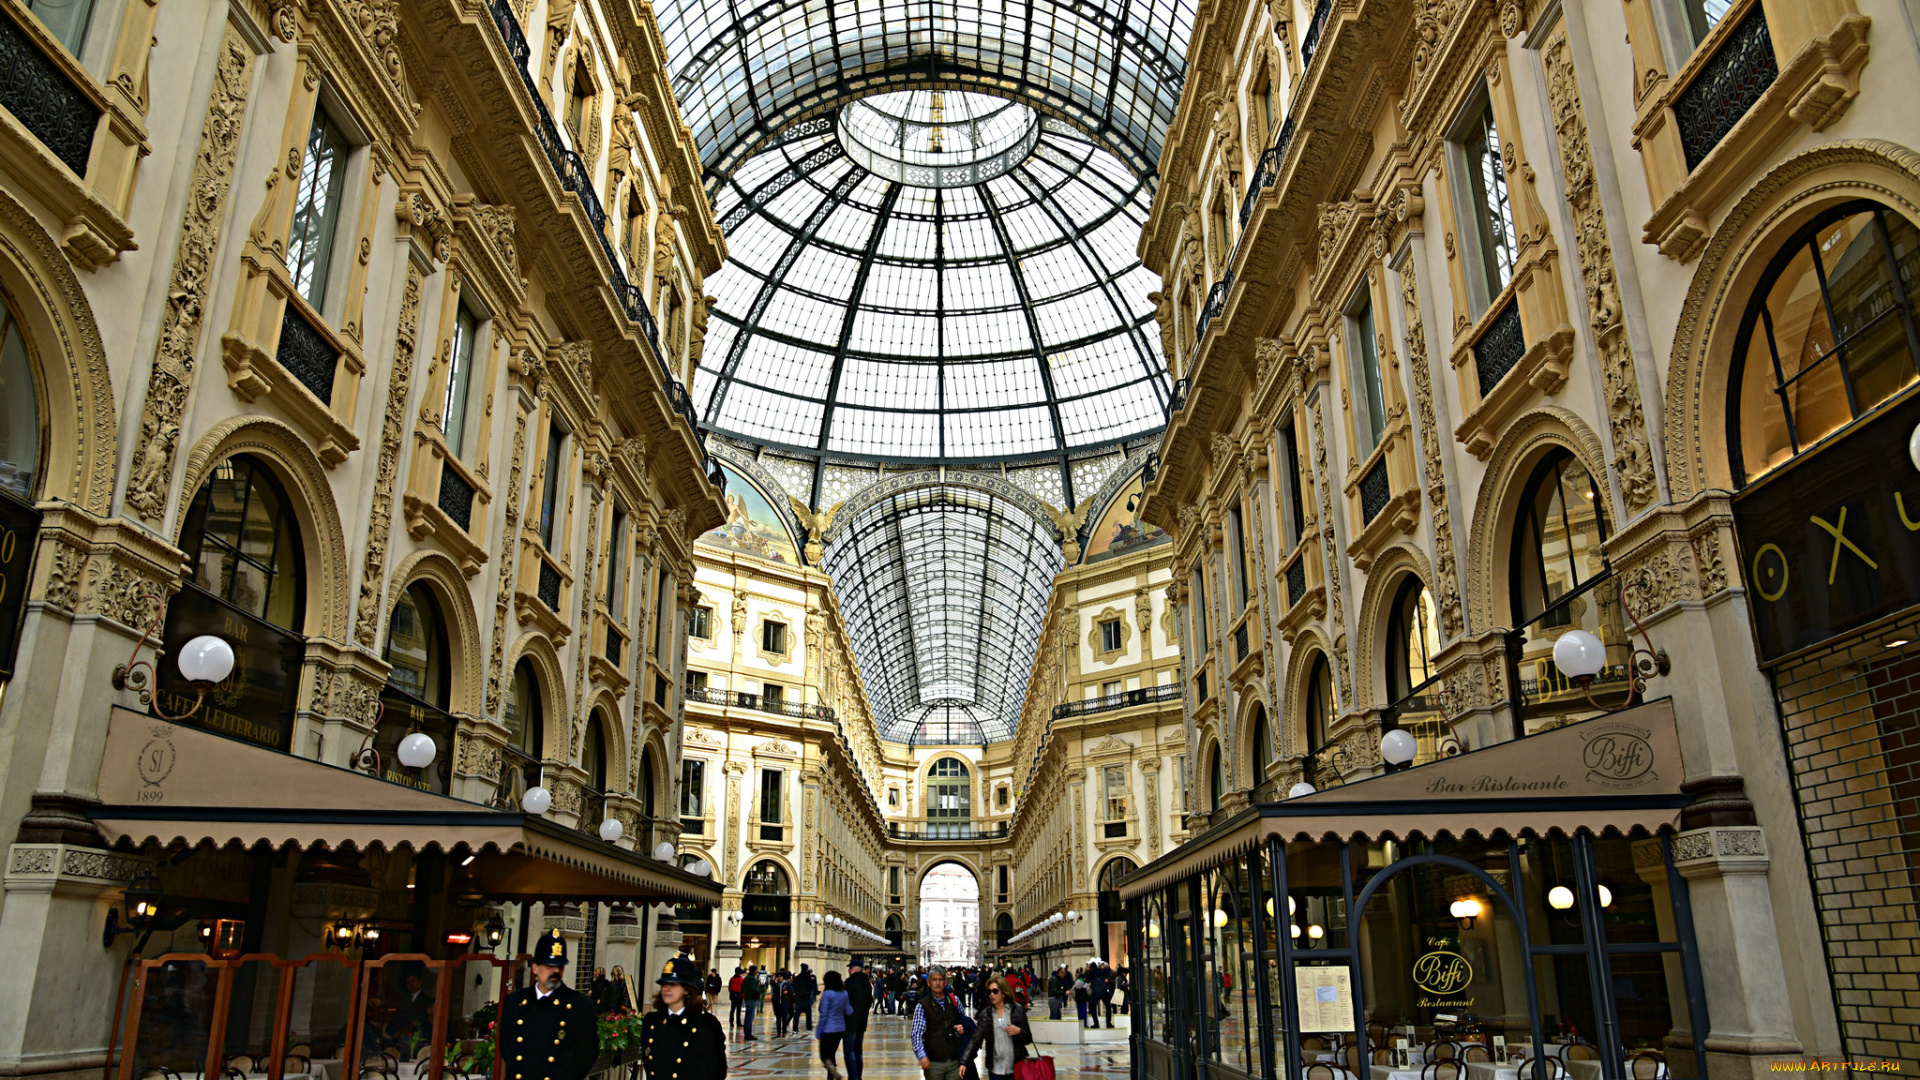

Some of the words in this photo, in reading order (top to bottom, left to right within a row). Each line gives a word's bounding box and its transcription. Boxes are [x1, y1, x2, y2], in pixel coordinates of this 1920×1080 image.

[225, 616, 248, 643] BAR
[410, 704, 425, 723] BAR
[204, 705, 280, 746] LETTERARIO
[149, 749, 164, 773] SI
[1586, 737, 1645, 777] Biffi
[1426, 776, 1466, 793] Bar
[1471, 774, 1569, 792] Ristorante
[136, 791, 164, 803] 1899
[753, 905, 777, 913] PRADA
[1427, 936, 1451, 951] Café
[1416, 955, 1465, 992] Biffi
[1416, 997, 1475, 1007] Restaurant
